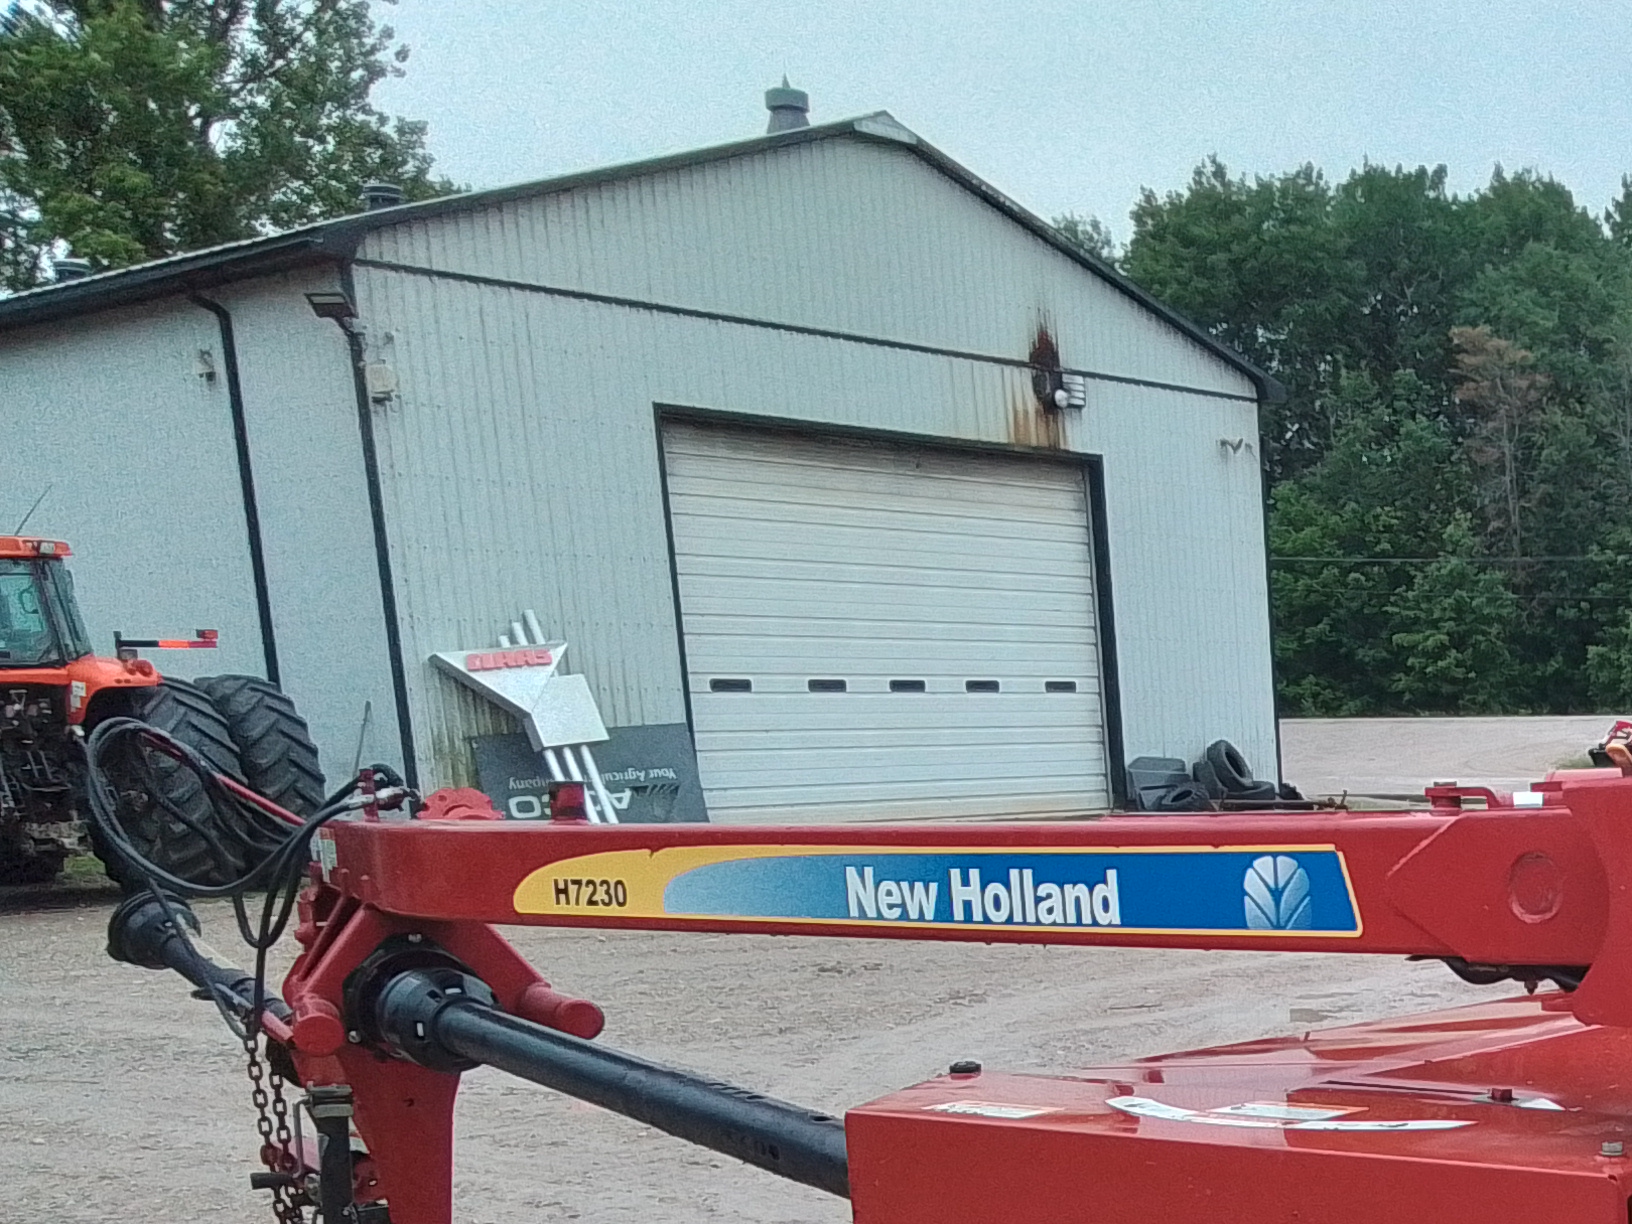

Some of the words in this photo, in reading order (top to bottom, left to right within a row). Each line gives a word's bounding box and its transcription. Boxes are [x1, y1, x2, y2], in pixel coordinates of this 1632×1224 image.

[467, 649, 552, 672] CLAAS
[553, 877, 628, 911] H7230
[844, 865, 938, 922] New
[950, 867, 1121, 927] Holland
